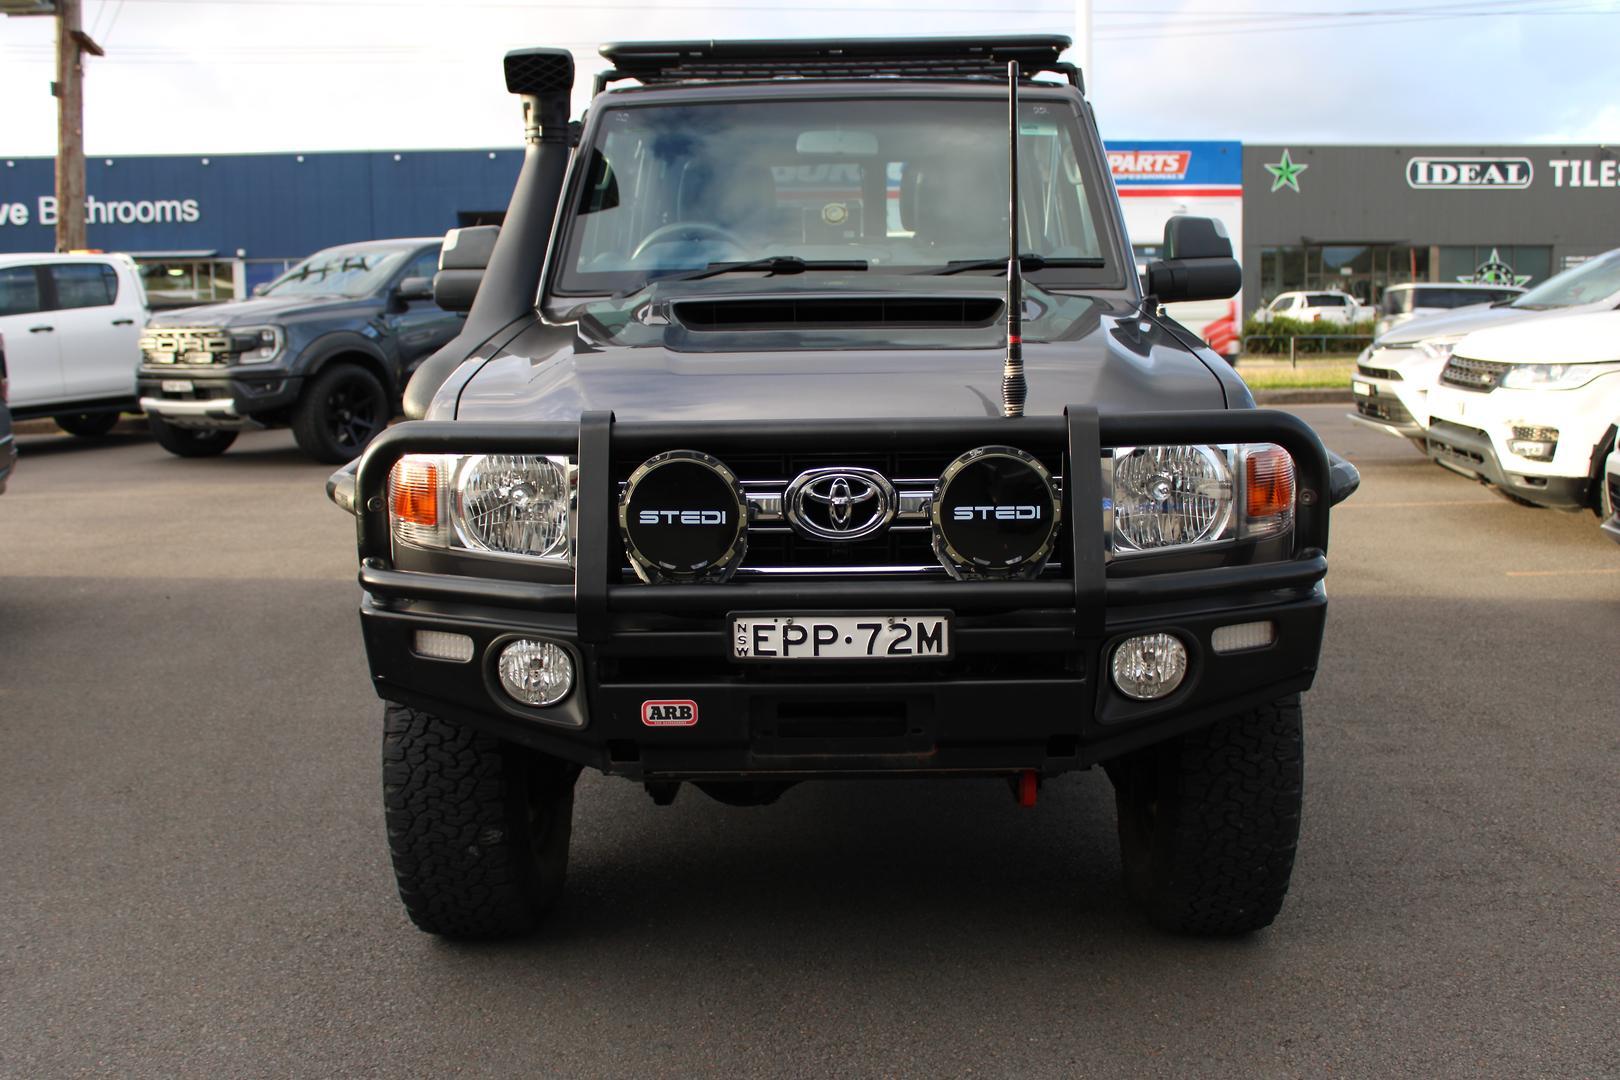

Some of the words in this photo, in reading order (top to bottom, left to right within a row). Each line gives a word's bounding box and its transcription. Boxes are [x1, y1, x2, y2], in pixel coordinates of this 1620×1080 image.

[1107, 153, 1180, 173] PARTS
[1415, 160, 1529, 185] IDEAL
[1549, 159, 1620, 187] TILE
[38, 195, 200, 225] Bhrooms
[639, 510, 727, 525] STEDI
[954, 505, 1041, 521] STEDI
[649, 705, 693, 720] ARB
